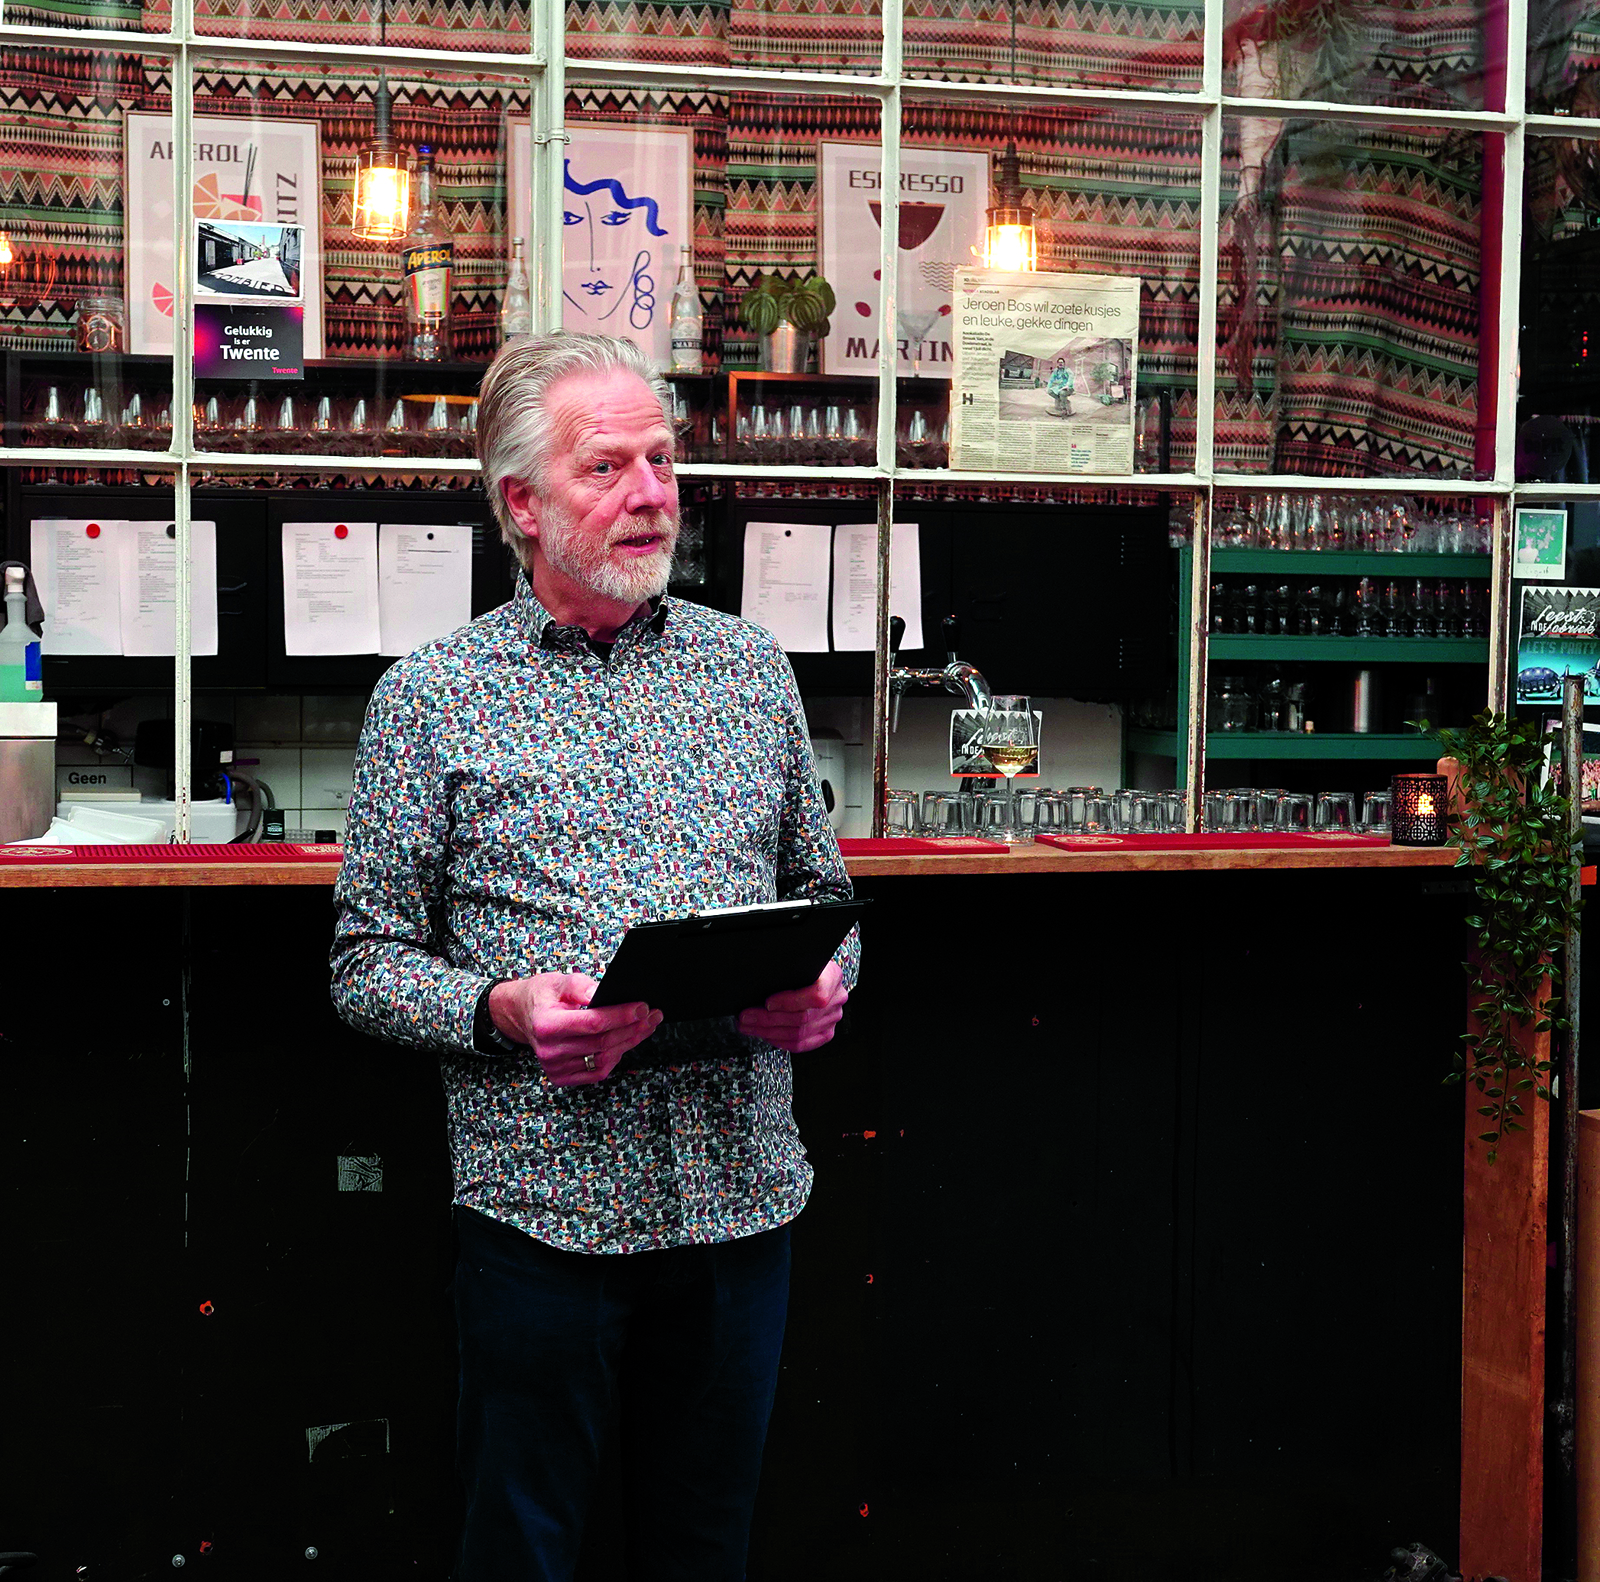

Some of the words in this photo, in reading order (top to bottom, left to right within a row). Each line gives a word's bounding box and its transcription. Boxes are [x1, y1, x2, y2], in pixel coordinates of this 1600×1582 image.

[150, 141, 243, 163] AROL
[276, 173, 298, 224] ITZ
[407, 249, 452, 270] APEROL
[962, 297, 1006, 311] Jeroen
[1007, 299, 1032, 312] Bos
[1033, 301, 1049, 313] wil
[1050, 303, 1083, 316] zoete
[1083, 303, 1121, 319] kusjes
[962, 315, 978, 326] en
[980, 314, 1015, 328] leuke,
[1016, 316, 1052, 330] gekke
[1053, 318, 1094, 333] dingen
[224, 325, 273, 339] Gelukkig
[220, 345, 280, 361] Twente
[271, 366, 299, 374] Twente
[962, 392, 974, 406] H
[1525, 641, 1557, 654] LET'S
[1560, 641, 1597, 655] PARTY
[68, 771, 107, 785] Geen
